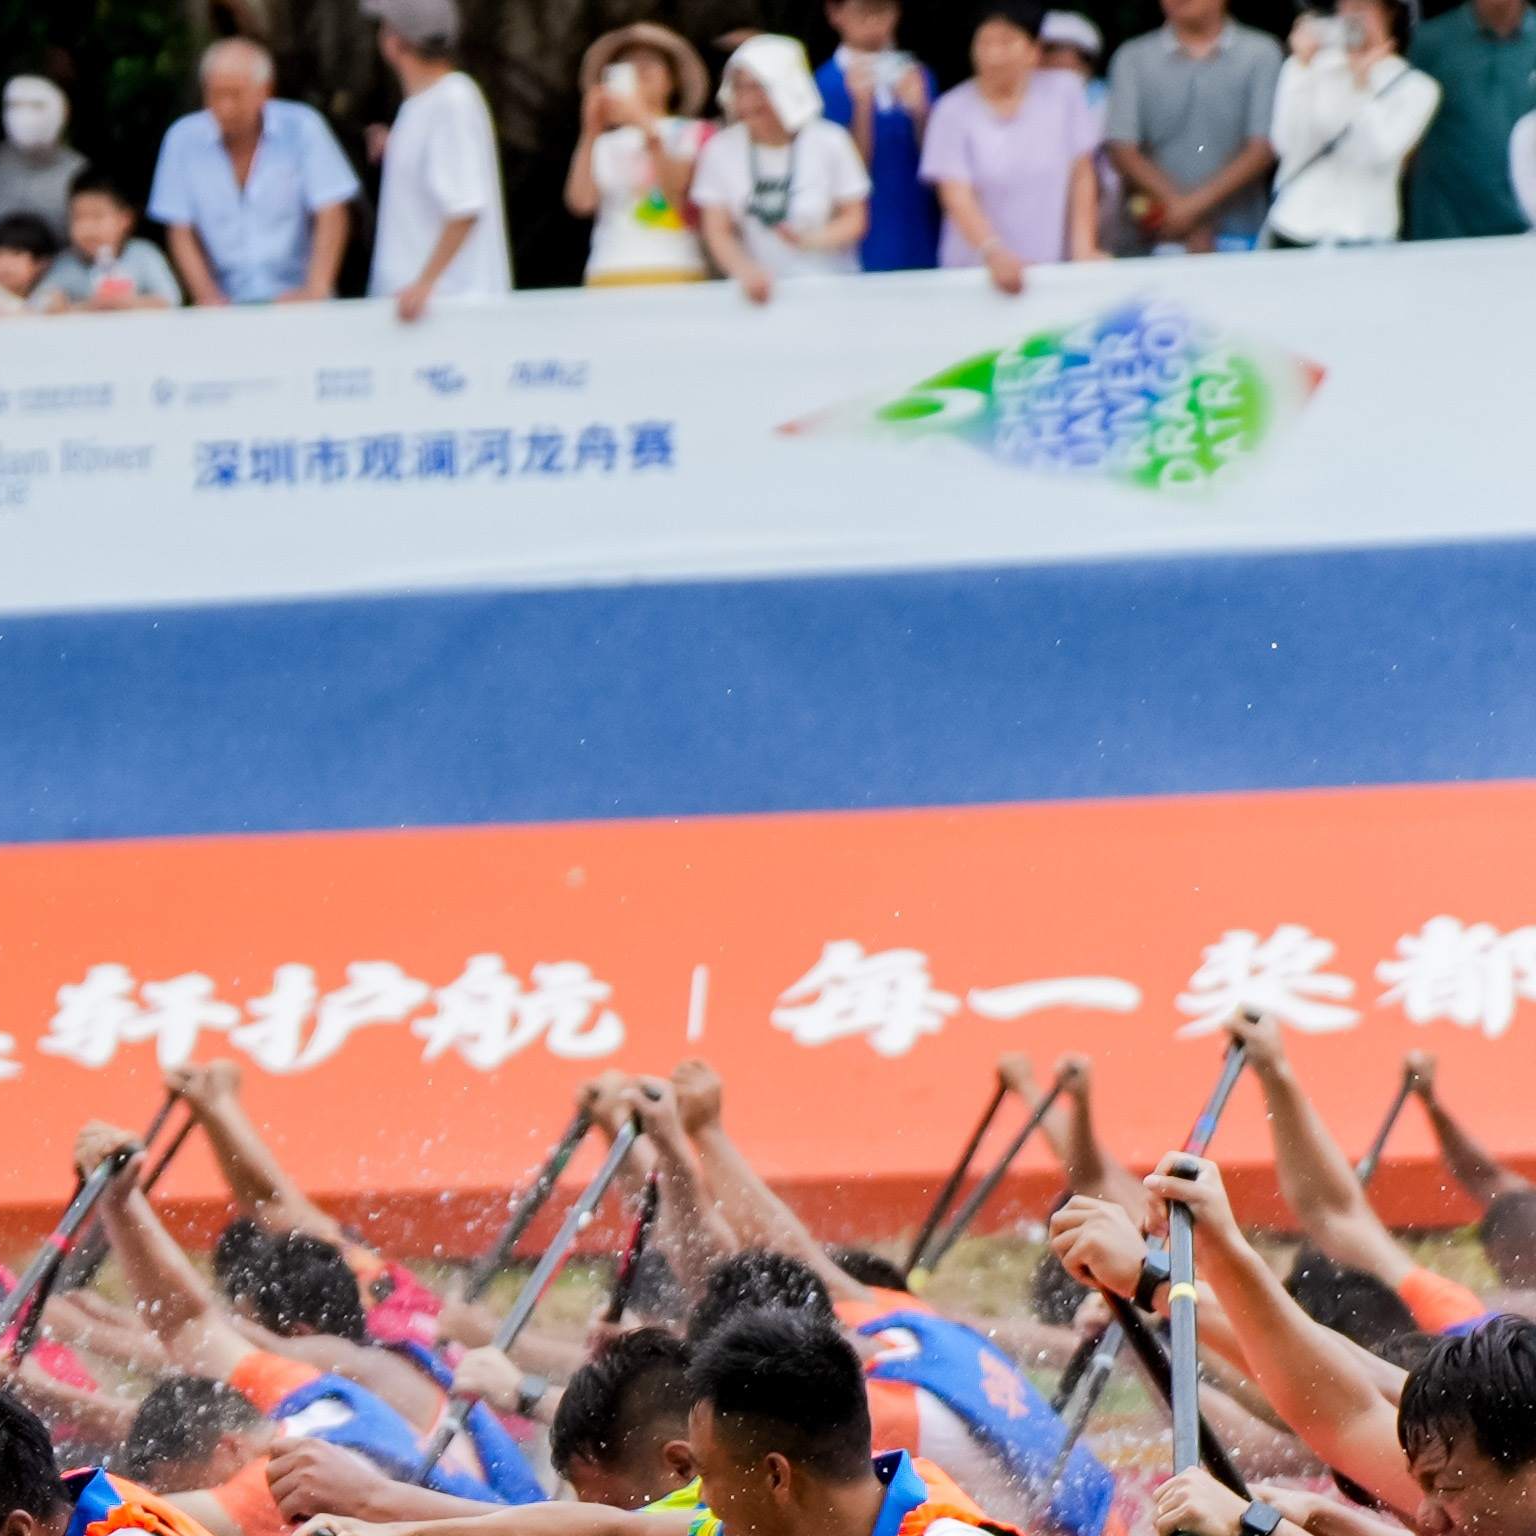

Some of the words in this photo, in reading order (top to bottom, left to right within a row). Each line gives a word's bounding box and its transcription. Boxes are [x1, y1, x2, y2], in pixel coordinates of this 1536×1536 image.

[60, 438, 154, 472] River
[194, 420, 677, 490] 深圳市观澜河龙舟赛
